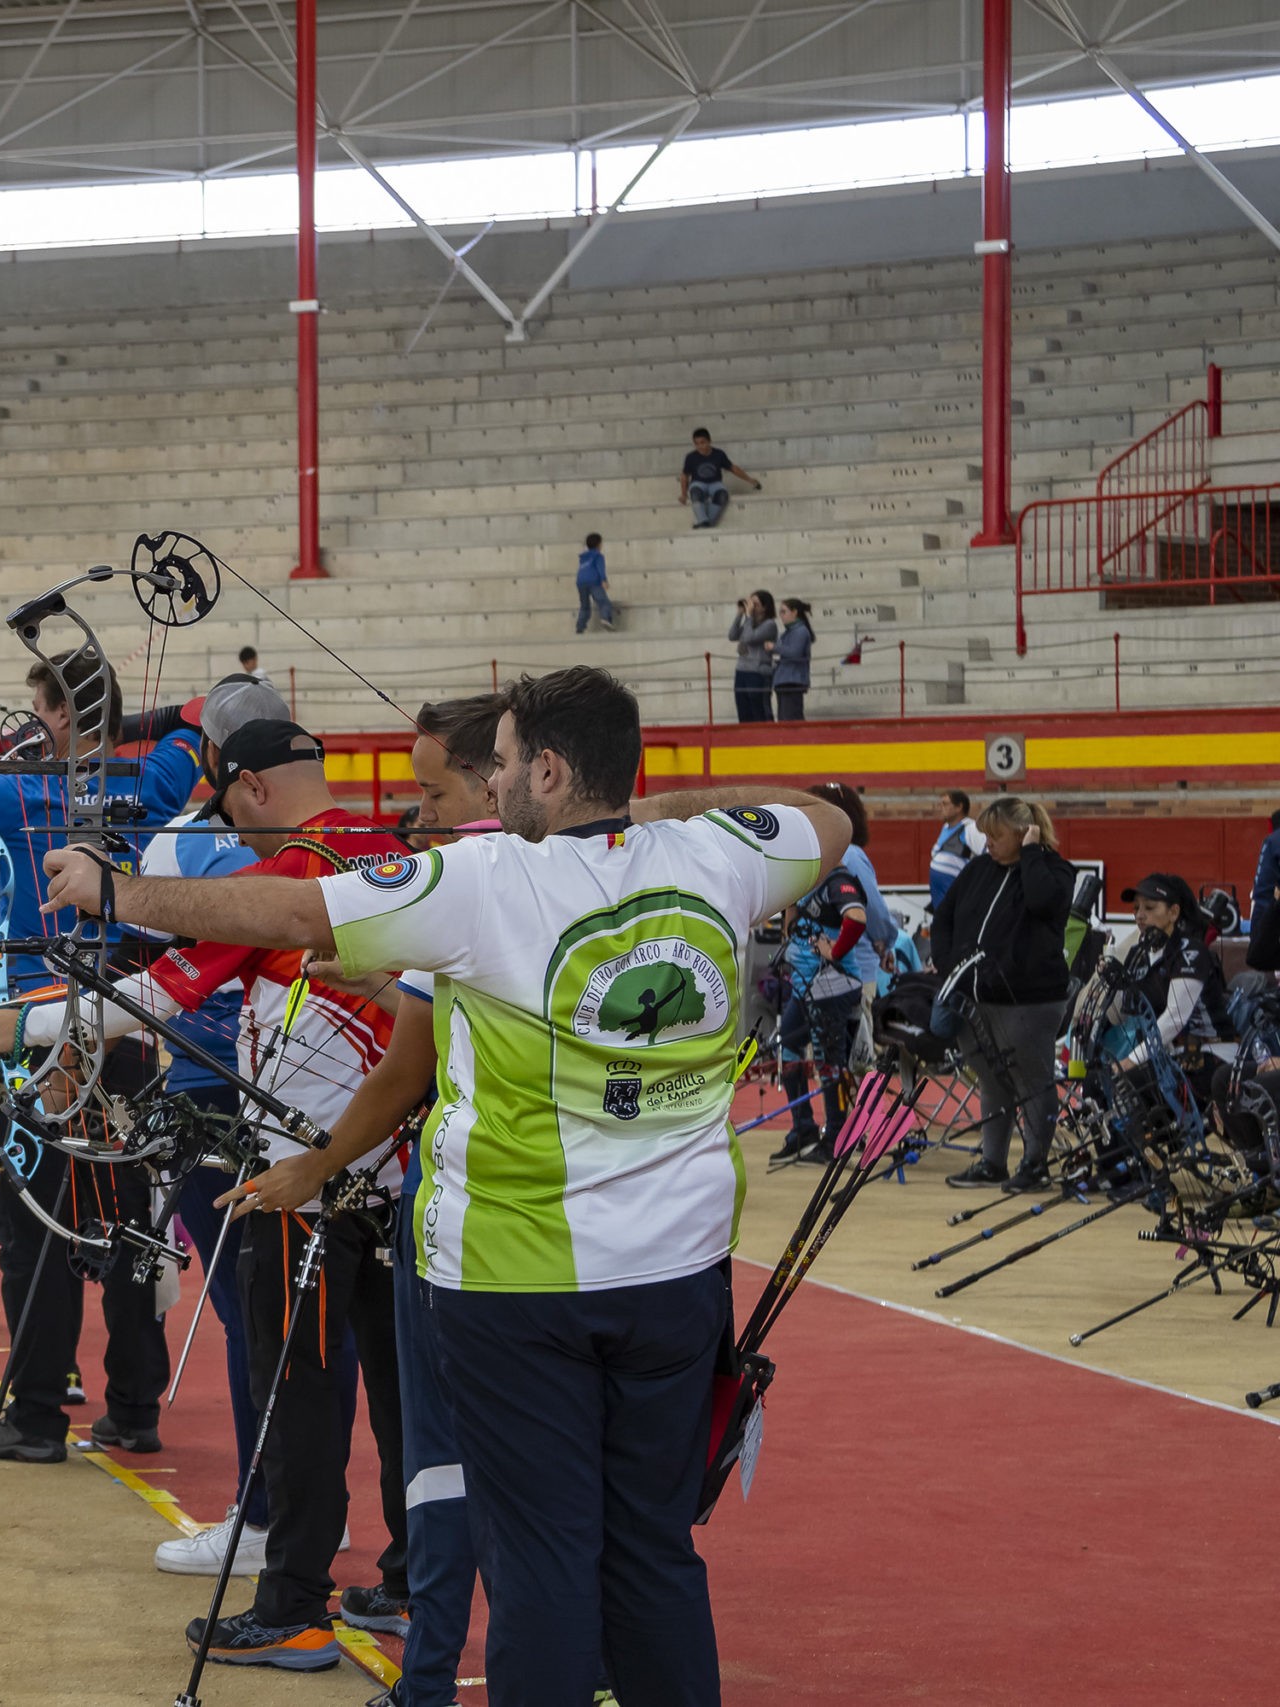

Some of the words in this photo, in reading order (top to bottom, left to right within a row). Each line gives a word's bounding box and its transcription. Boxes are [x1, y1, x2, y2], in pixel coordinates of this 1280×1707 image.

[996, 744, 1014, 770] 3
[577, 1005, 596, 1036] CLUB
[633, 943, 662, 966] ARCO
[692, 954, 726, 1010] BOADILLA
[646, 1072, 706, 1096] Boadilla
[646, 1097, 664, 1107] del
[425, 1184, 445, 1272] ARCO
